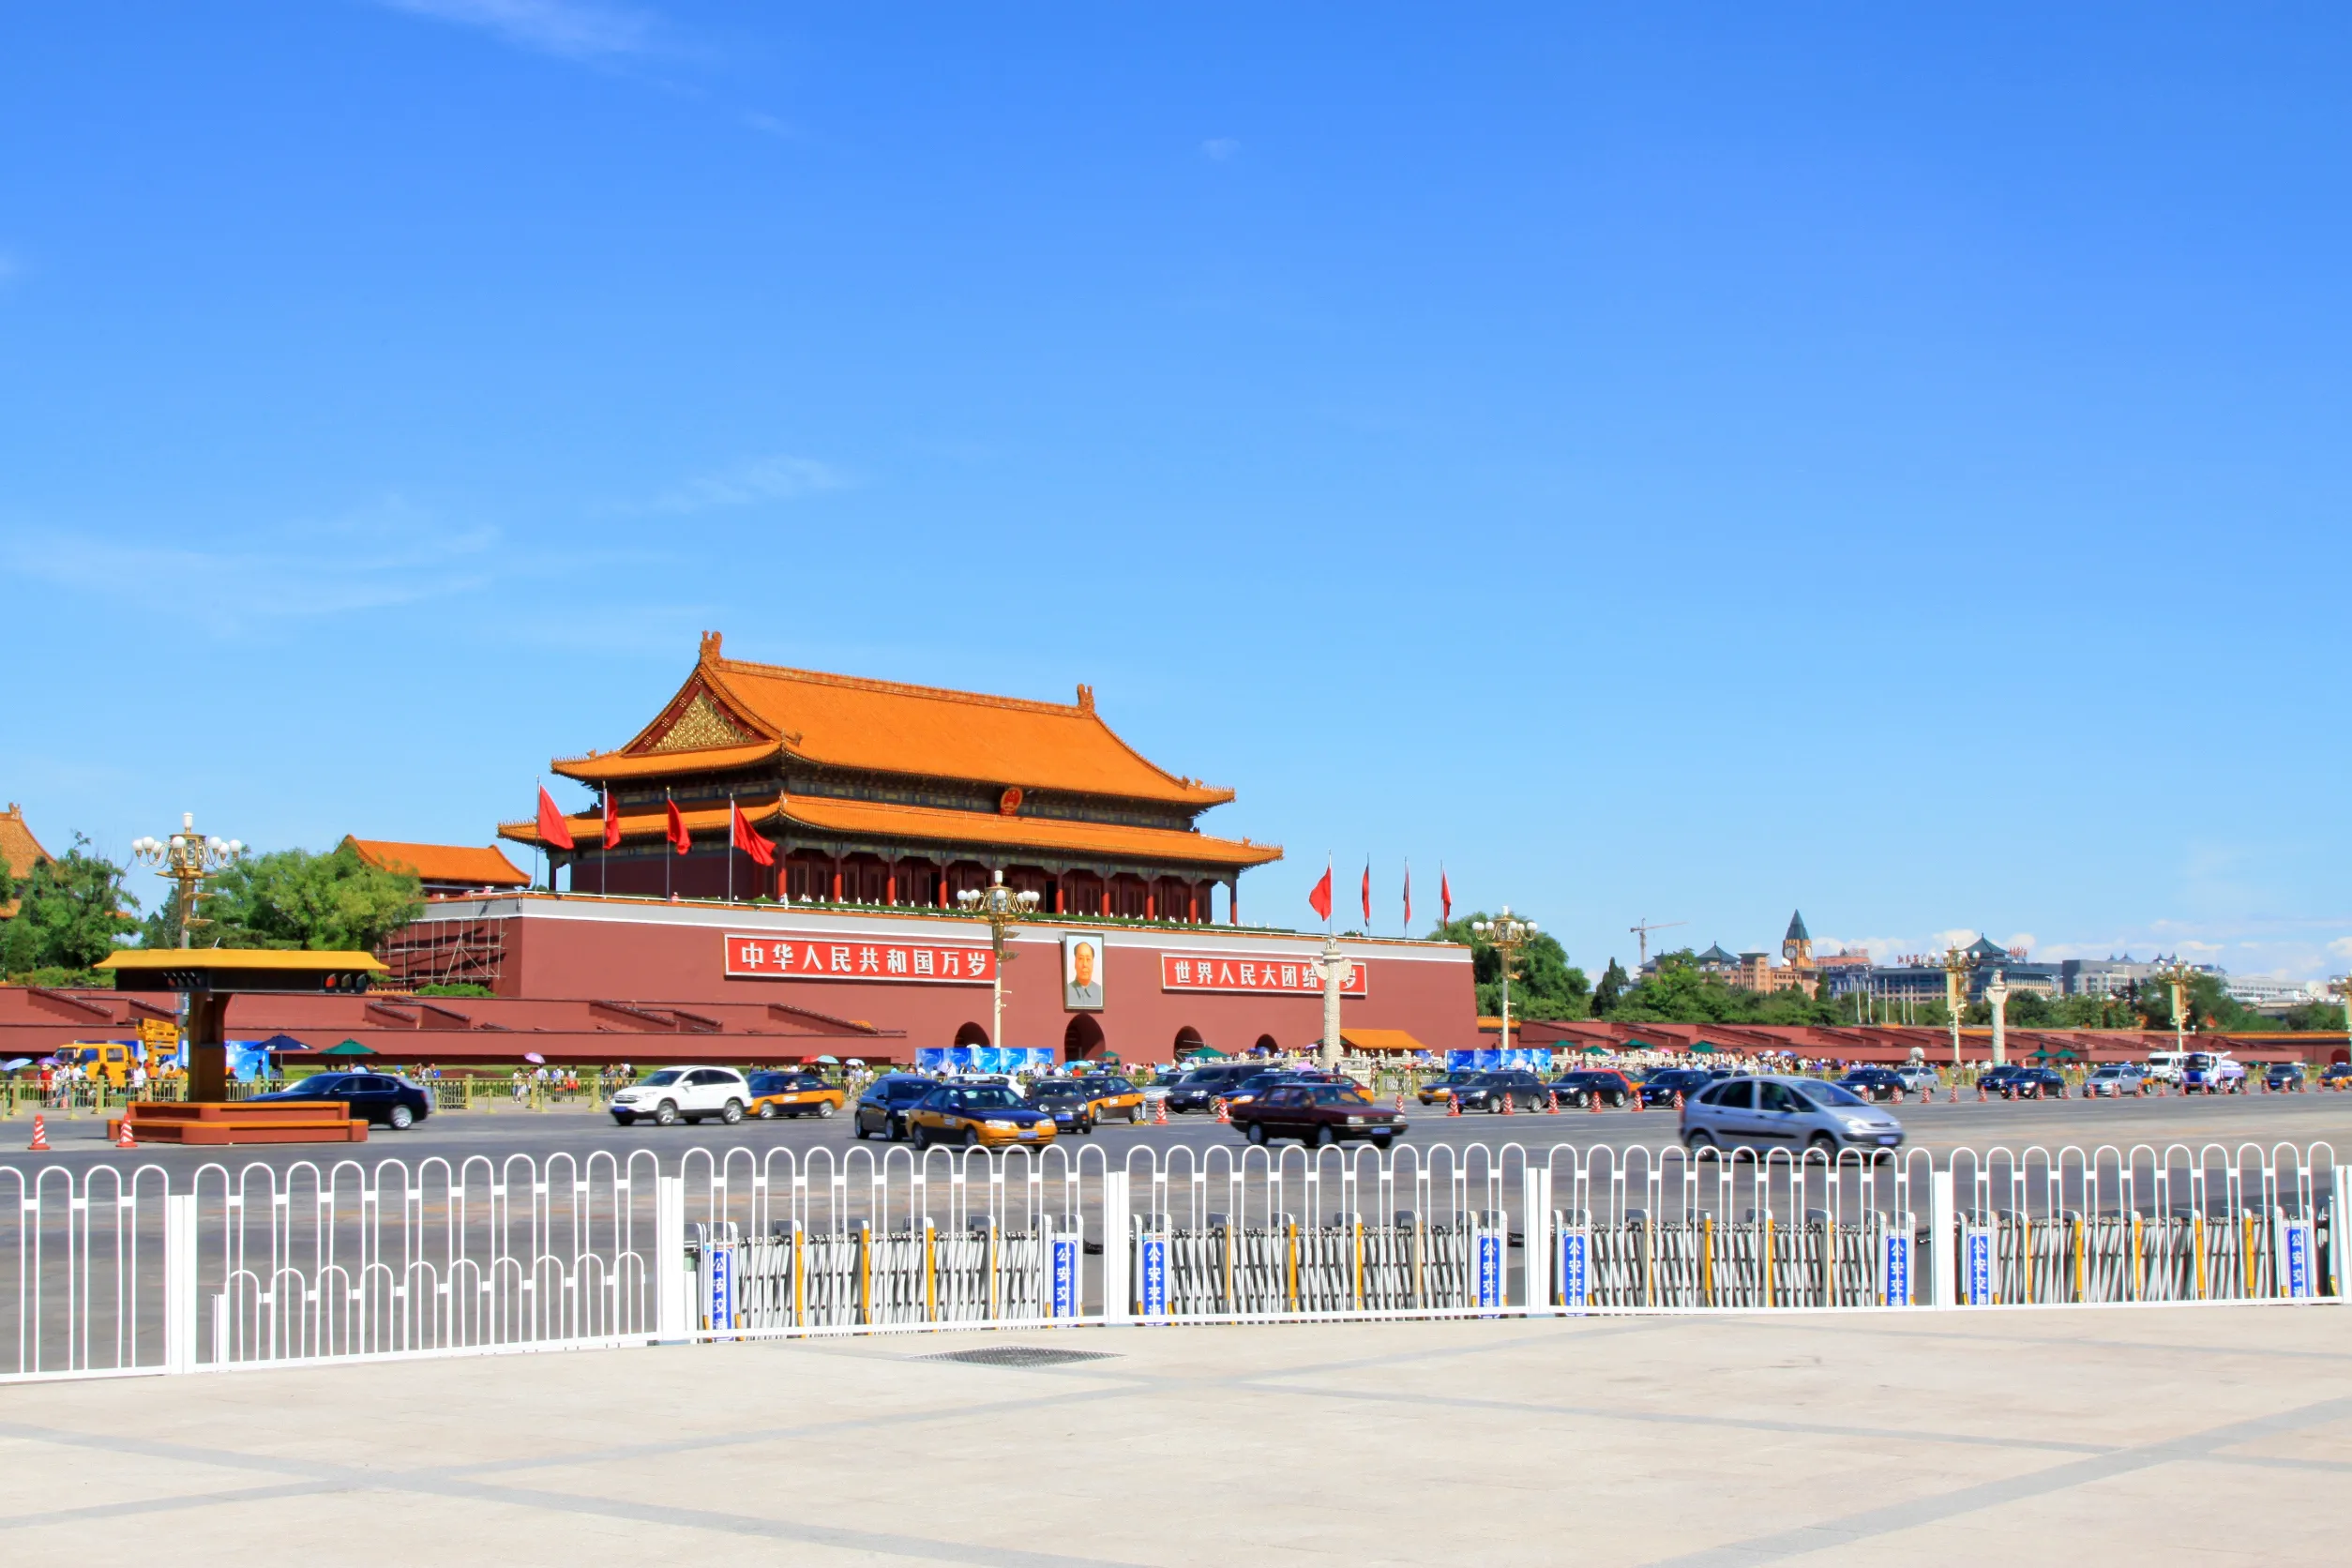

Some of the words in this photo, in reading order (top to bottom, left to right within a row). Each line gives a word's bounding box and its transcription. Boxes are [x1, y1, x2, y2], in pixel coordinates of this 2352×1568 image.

[742, 942, 986, 976] 中华人民共和国万岁
[1174, 960, 1356, 989] 世界人民大团结岁
